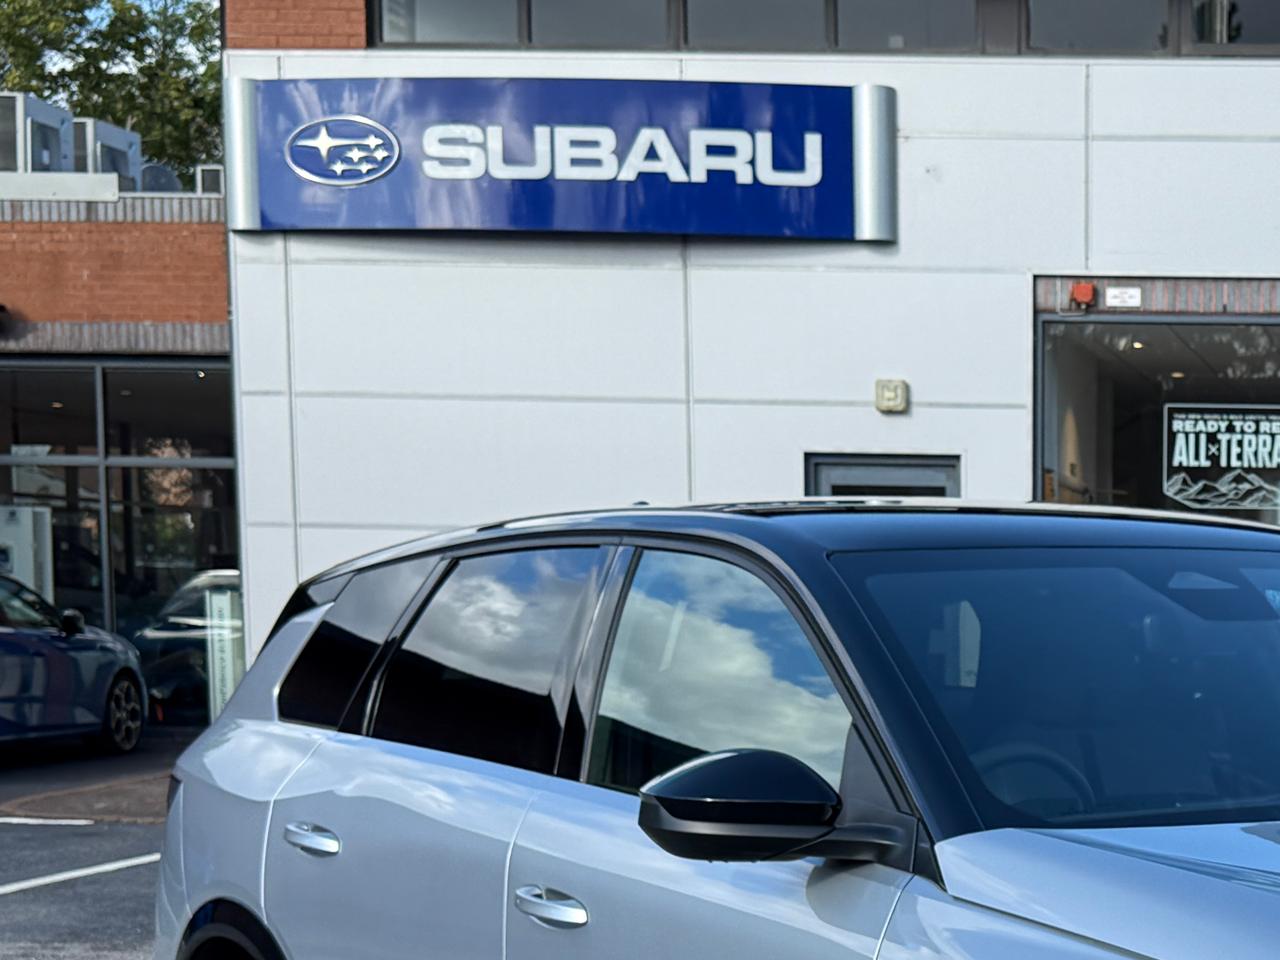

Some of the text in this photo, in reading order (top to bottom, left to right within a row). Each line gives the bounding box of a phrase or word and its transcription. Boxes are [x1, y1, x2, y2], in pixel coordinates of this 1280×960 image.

[421, 123, 822, 186] SUBARU
[1172, 420, 1229, 432] READY
[1233, 421, 1256, 432] TO
